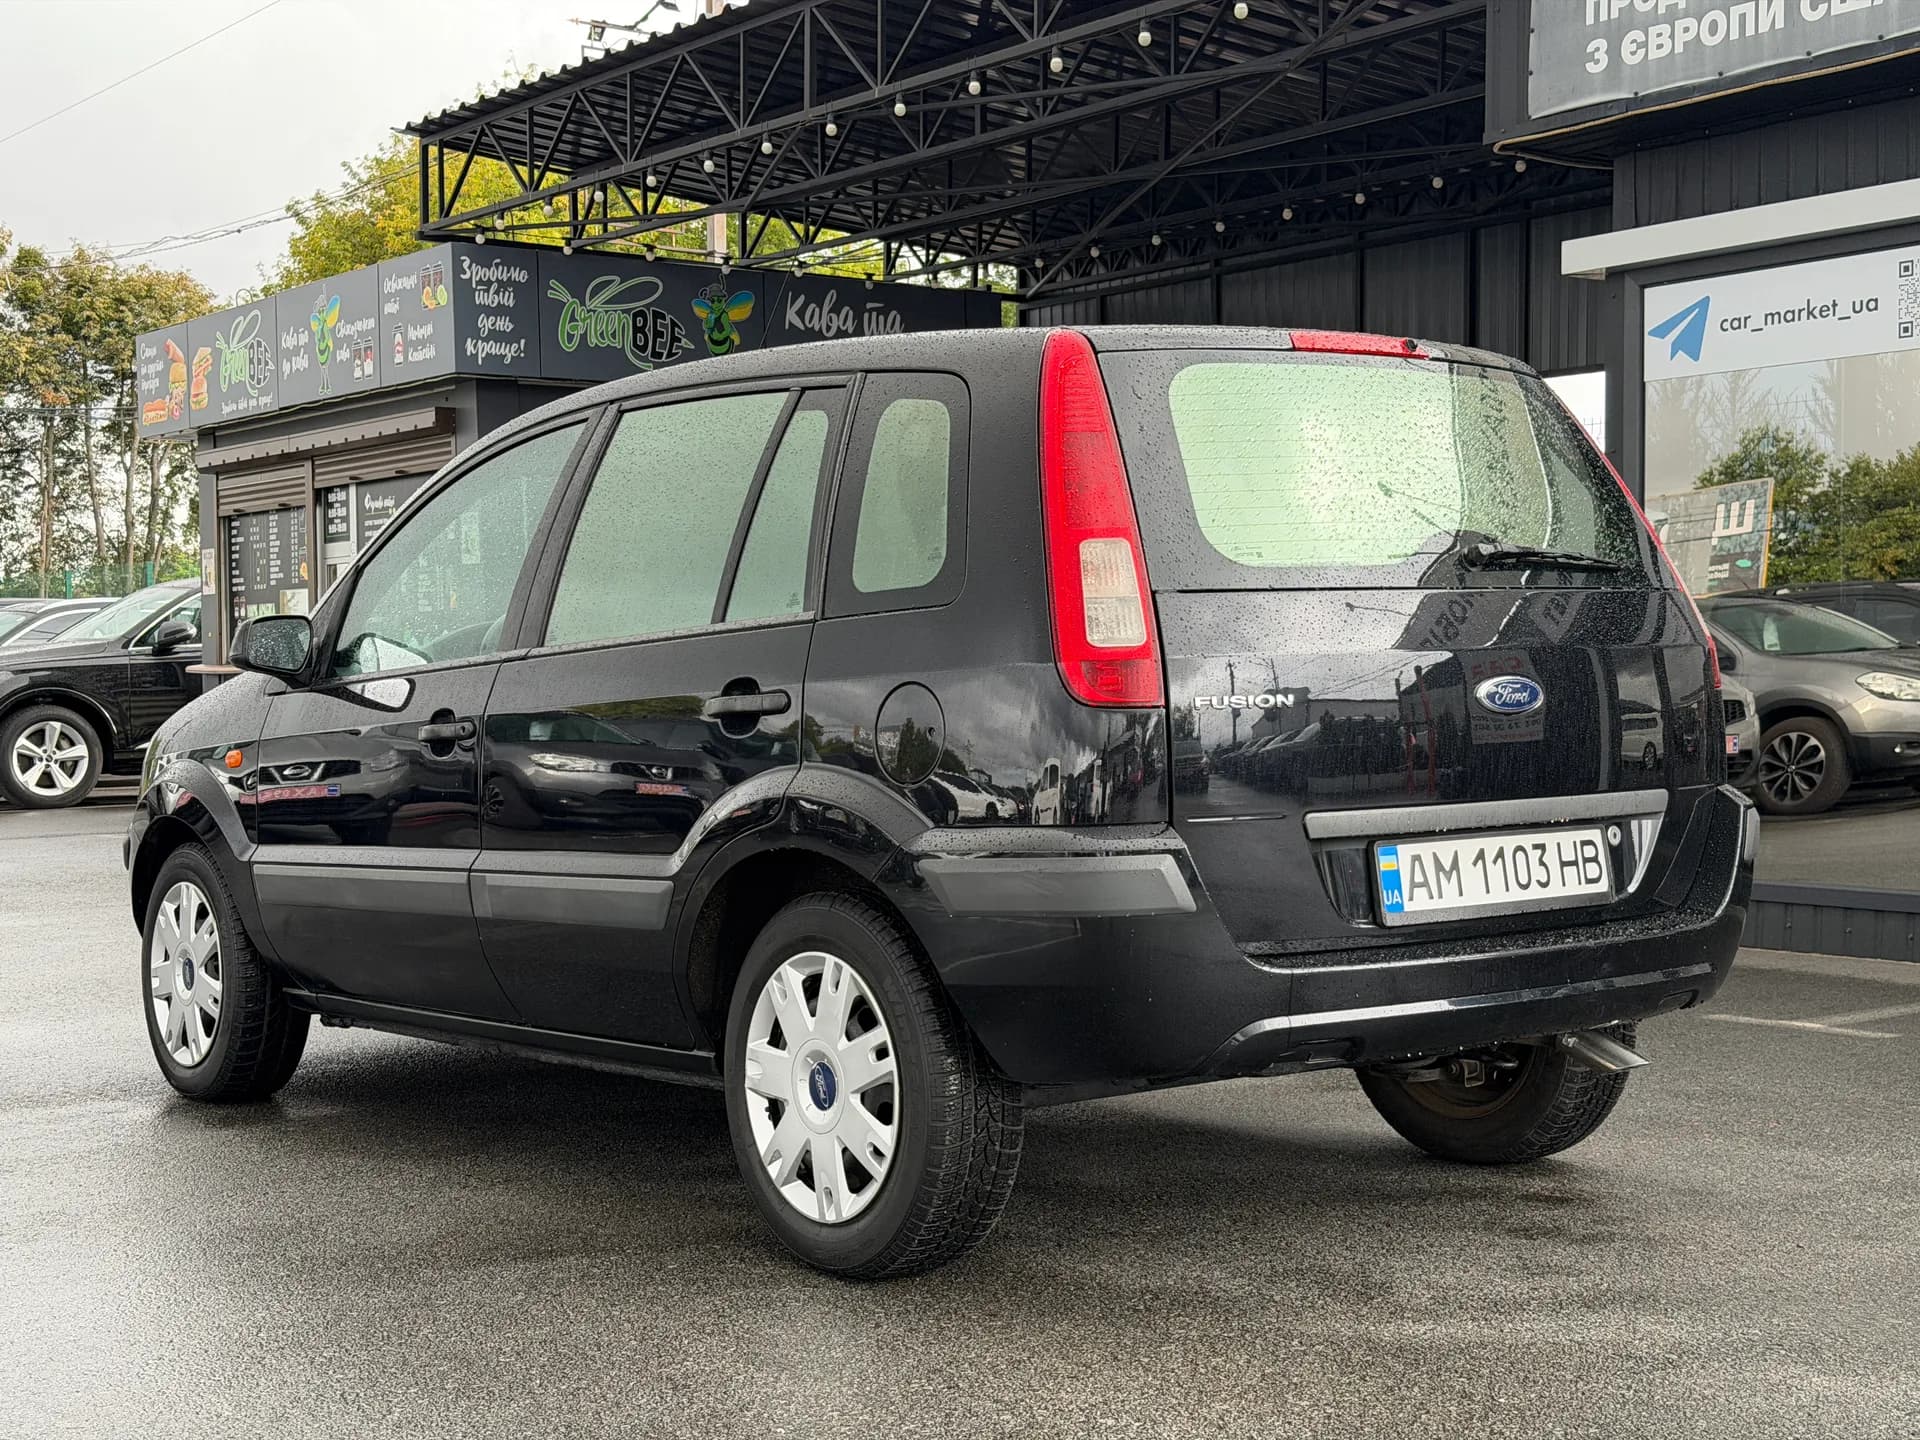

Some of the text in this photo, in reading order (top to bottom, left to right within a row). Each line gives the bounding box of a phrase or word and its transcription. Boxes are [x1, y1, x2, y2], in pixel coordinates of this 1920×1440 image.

[1585, 38, 1609, 74] З
[1620, 2, 1786, 66] ЄВРОПИ
[460, 255, 528, 289] Зробимо
[475, 282, 515, 307] твій
[478, 313, 514, 337] день
[785, 289, 905, 338] Кава та
[1720, 296, 1879, 332] car_market_ua
[465, 337, 526, 365] краще!
[1193, 694, 1295, 711] FUSION
[1495, 683, 1531, 705] Ford
[1408, 839, 1603, 902] AM 1103 HB
[1383, 889, 1402, 905] UA
